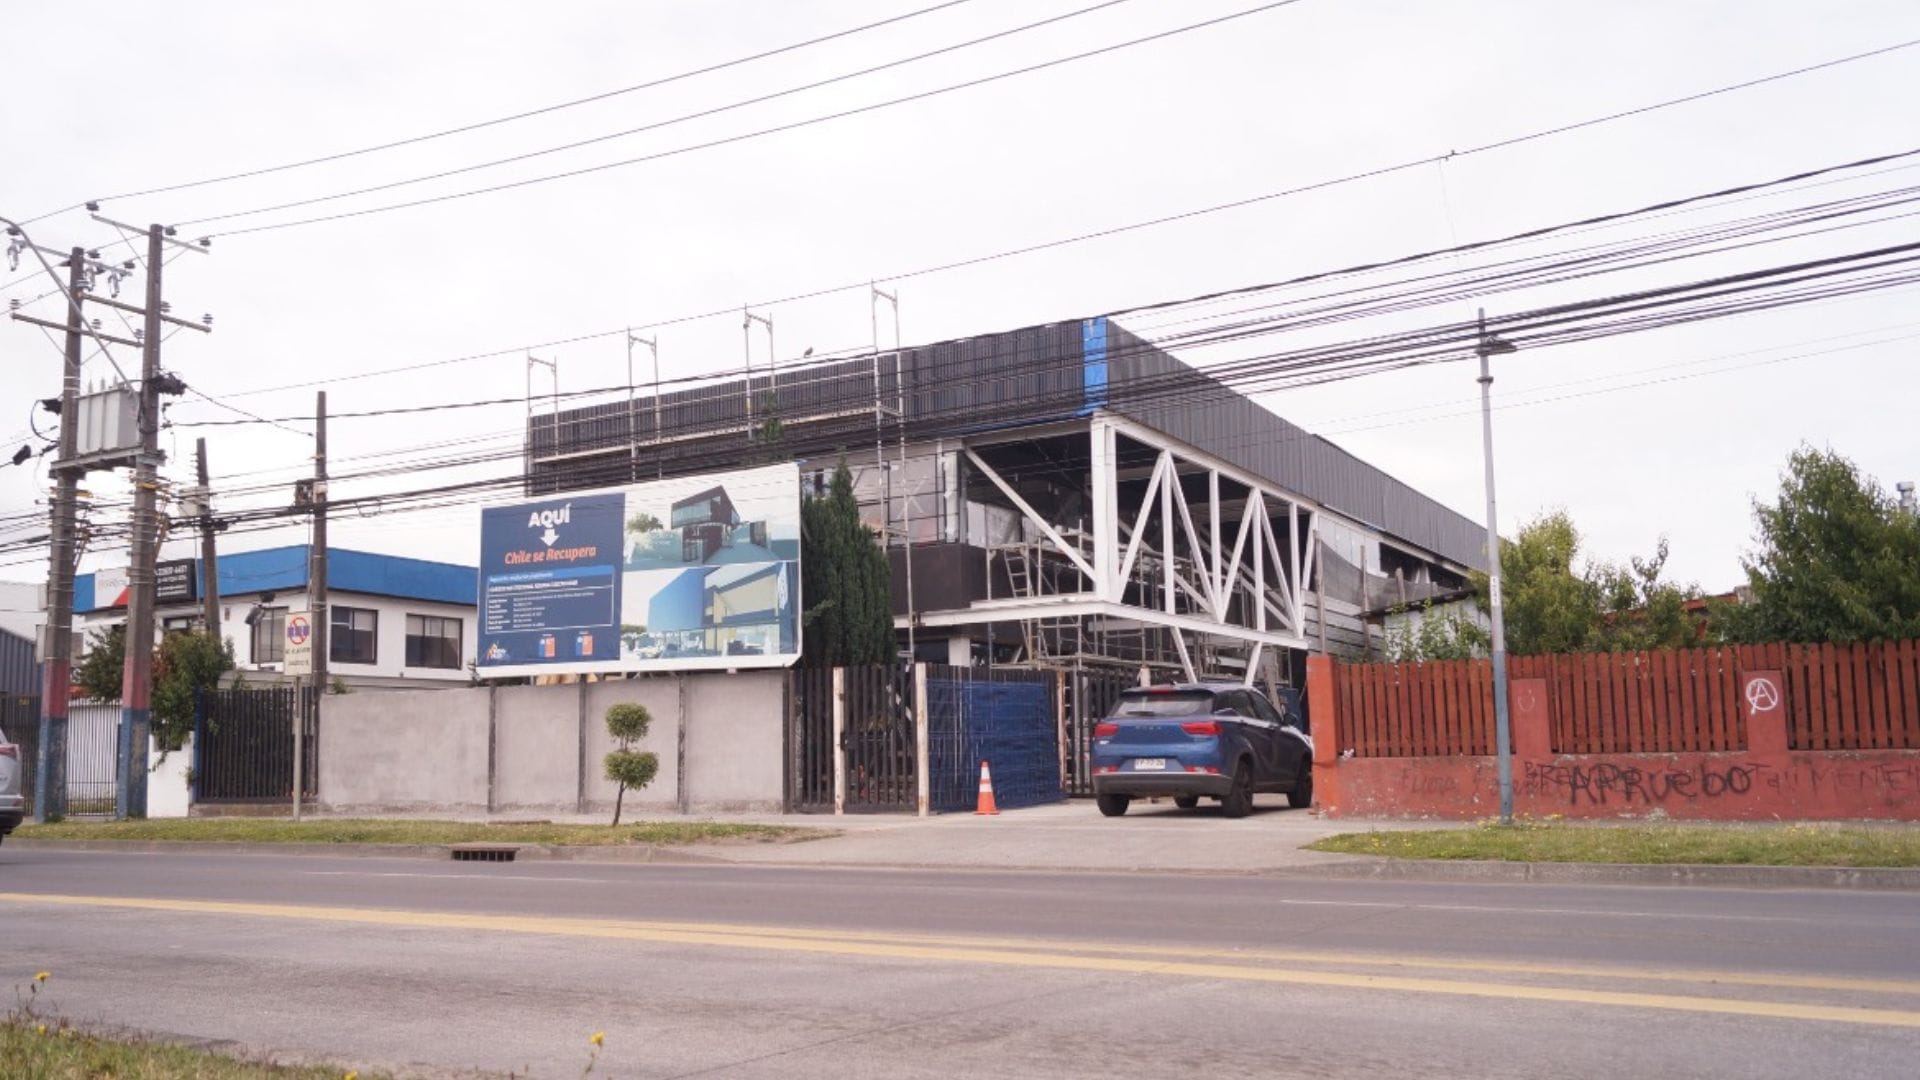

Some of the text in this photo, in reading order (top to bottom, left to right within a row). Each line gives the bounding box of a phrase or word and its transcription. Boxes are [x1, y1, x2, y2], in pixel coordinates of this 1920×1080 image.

[528, 502, 572, 528] AQUÍ
[504, 546, 597, 564] Chile se Recupera
